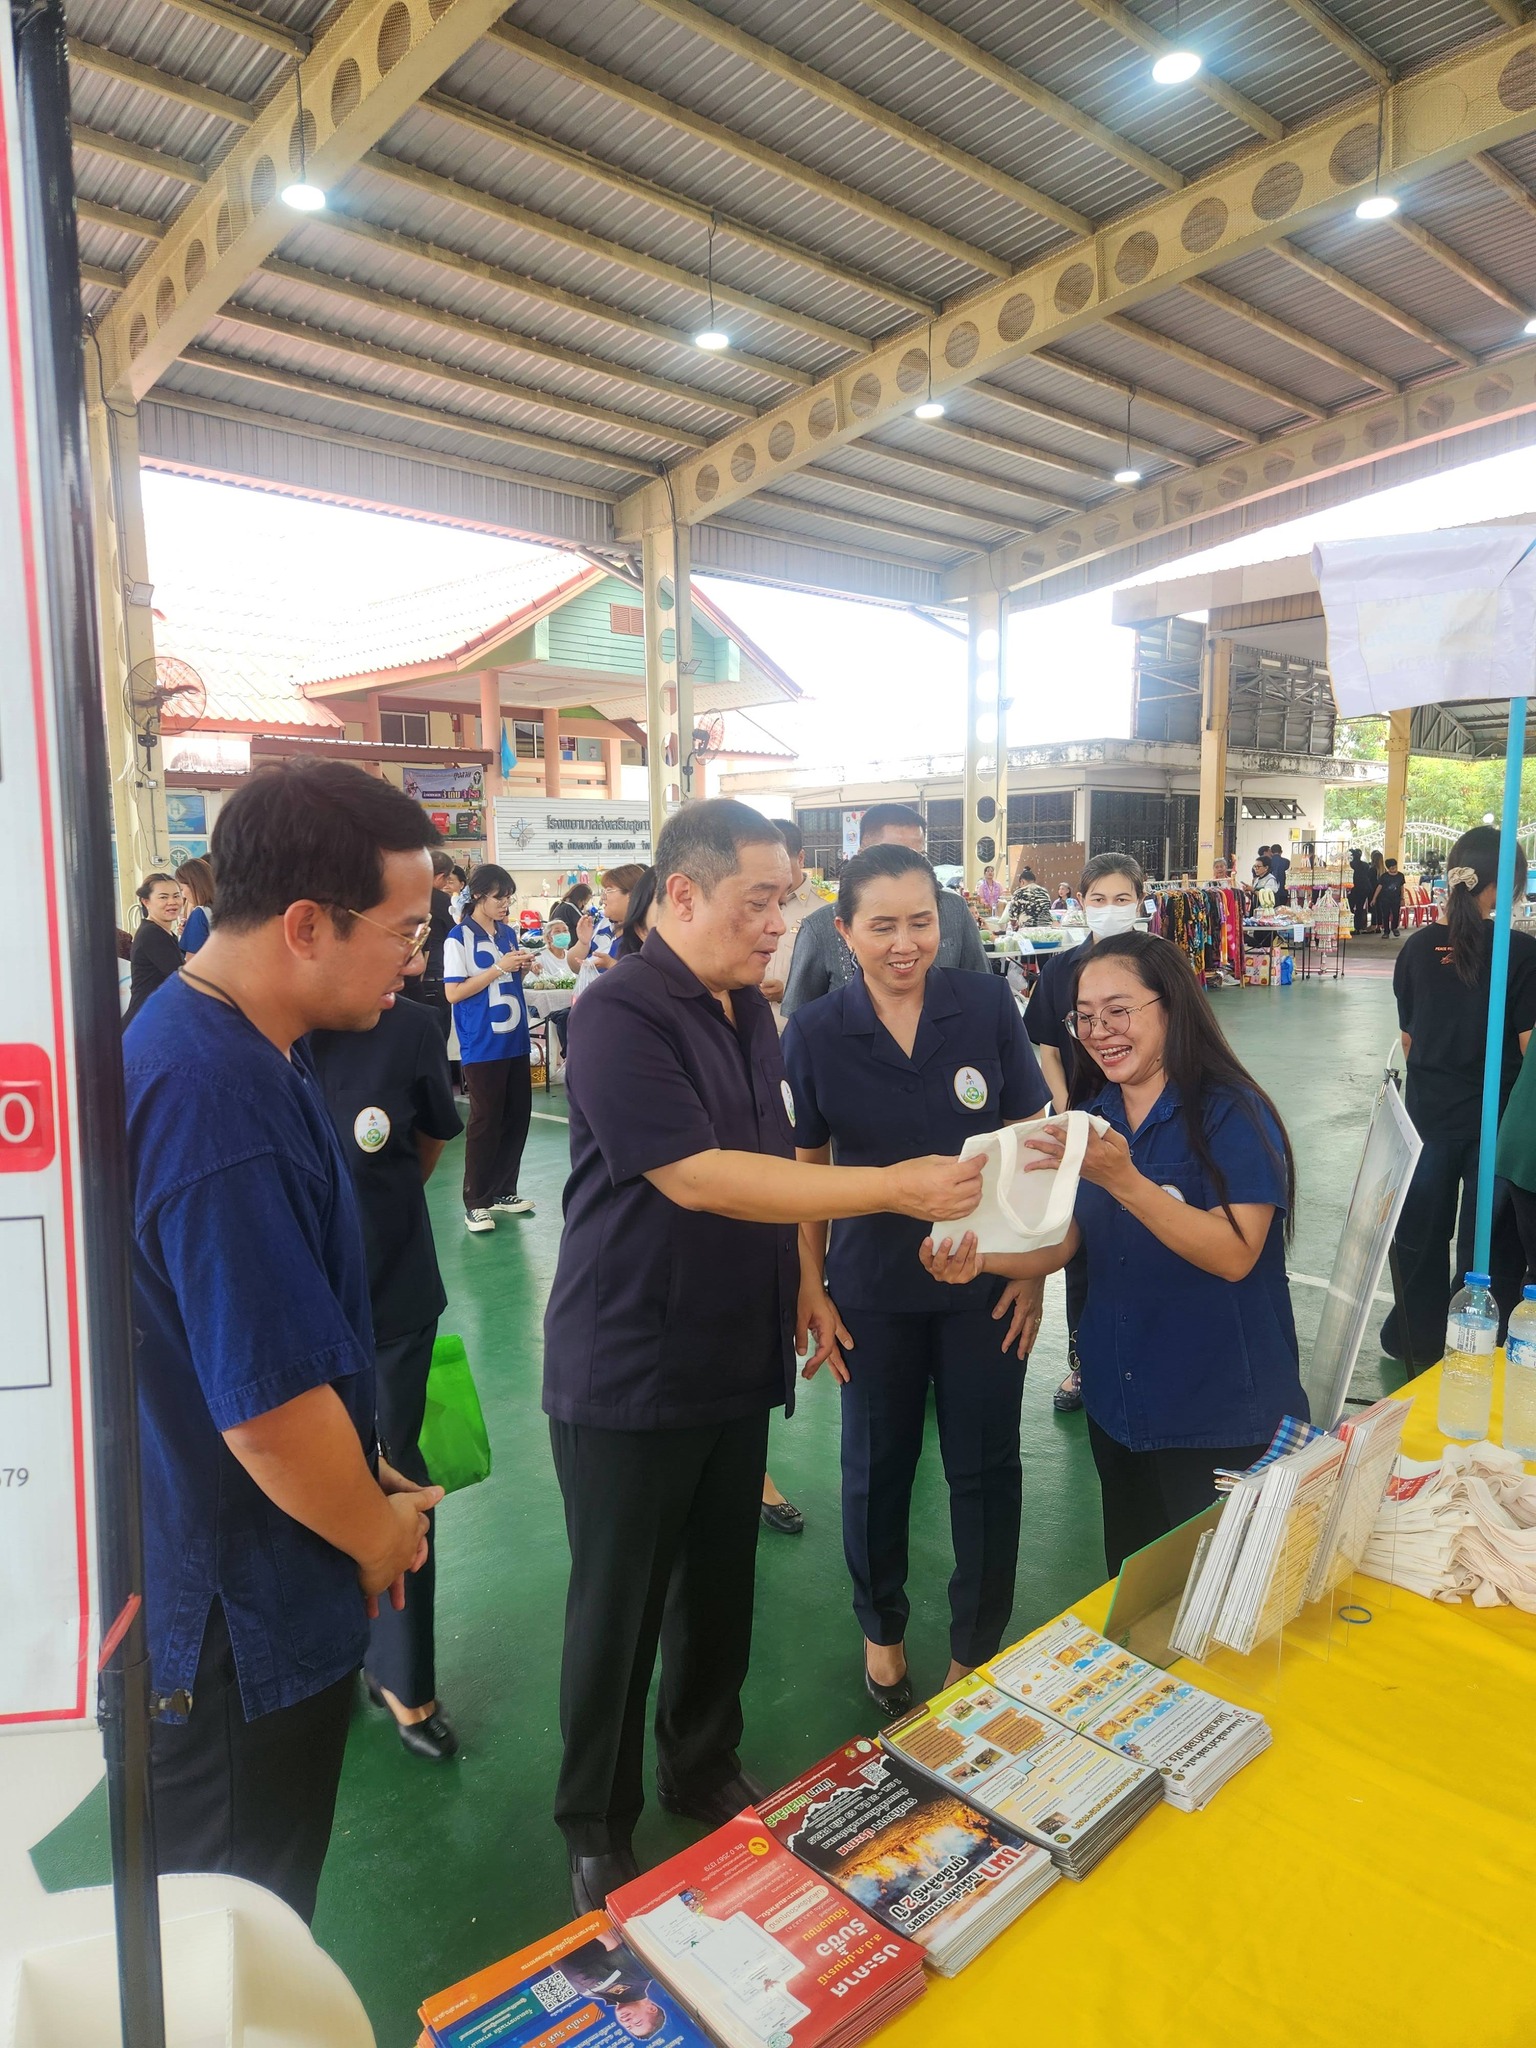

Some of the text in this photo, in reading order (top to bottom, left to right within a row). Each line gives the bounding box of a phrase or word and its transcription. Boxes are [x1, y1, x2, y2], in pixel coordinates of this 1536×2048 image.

[0, 1467, 29, 1487] 79
[806, 1777, 835, 1798] ไม่เผา
[835, 1825, 874, 1856] ประกาศ
[905, 1845, 1021, 1932] เผา ในพื้นที่การเกษตร
[889, 1903, 905, 1919] ปี
[900, 1894, 917, 1911] 2
[801, 1904, 850, 1943] ที่ดินเอกชน
[814, 1916, 869, 1959] รับซื้อ
[815, 1932, 882, 1986] ส.ป.ก.ปทุมธานี
[828, 1941, 901, 1998] ประกาศ
[537, 2039, 546, 2048] 9
[546, 2028, 566, 2046] วันที่
